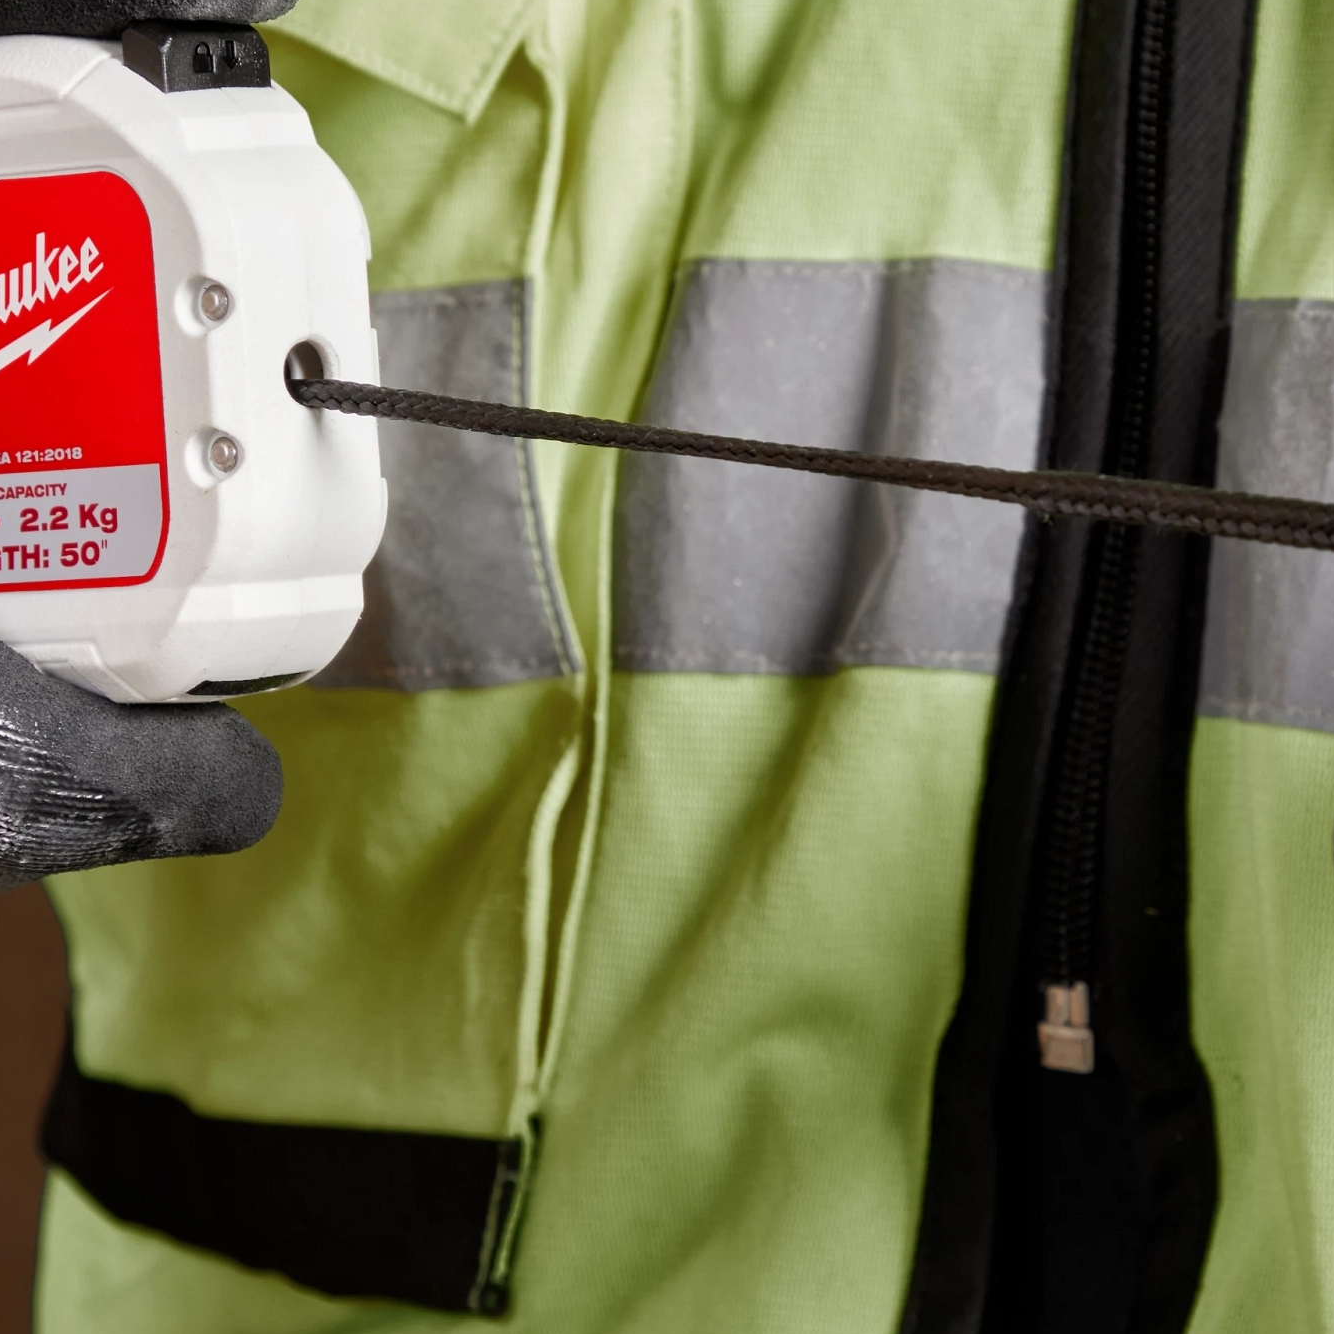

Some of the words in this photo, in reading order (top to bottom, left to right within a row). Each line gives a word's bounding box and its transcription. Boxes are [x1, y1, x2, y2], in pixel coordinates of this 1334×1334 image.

[15, 447, 83, 464] 121:2018
[19, 505, 69, 533] 2.2
[79, 503, 119, 534] Kg
